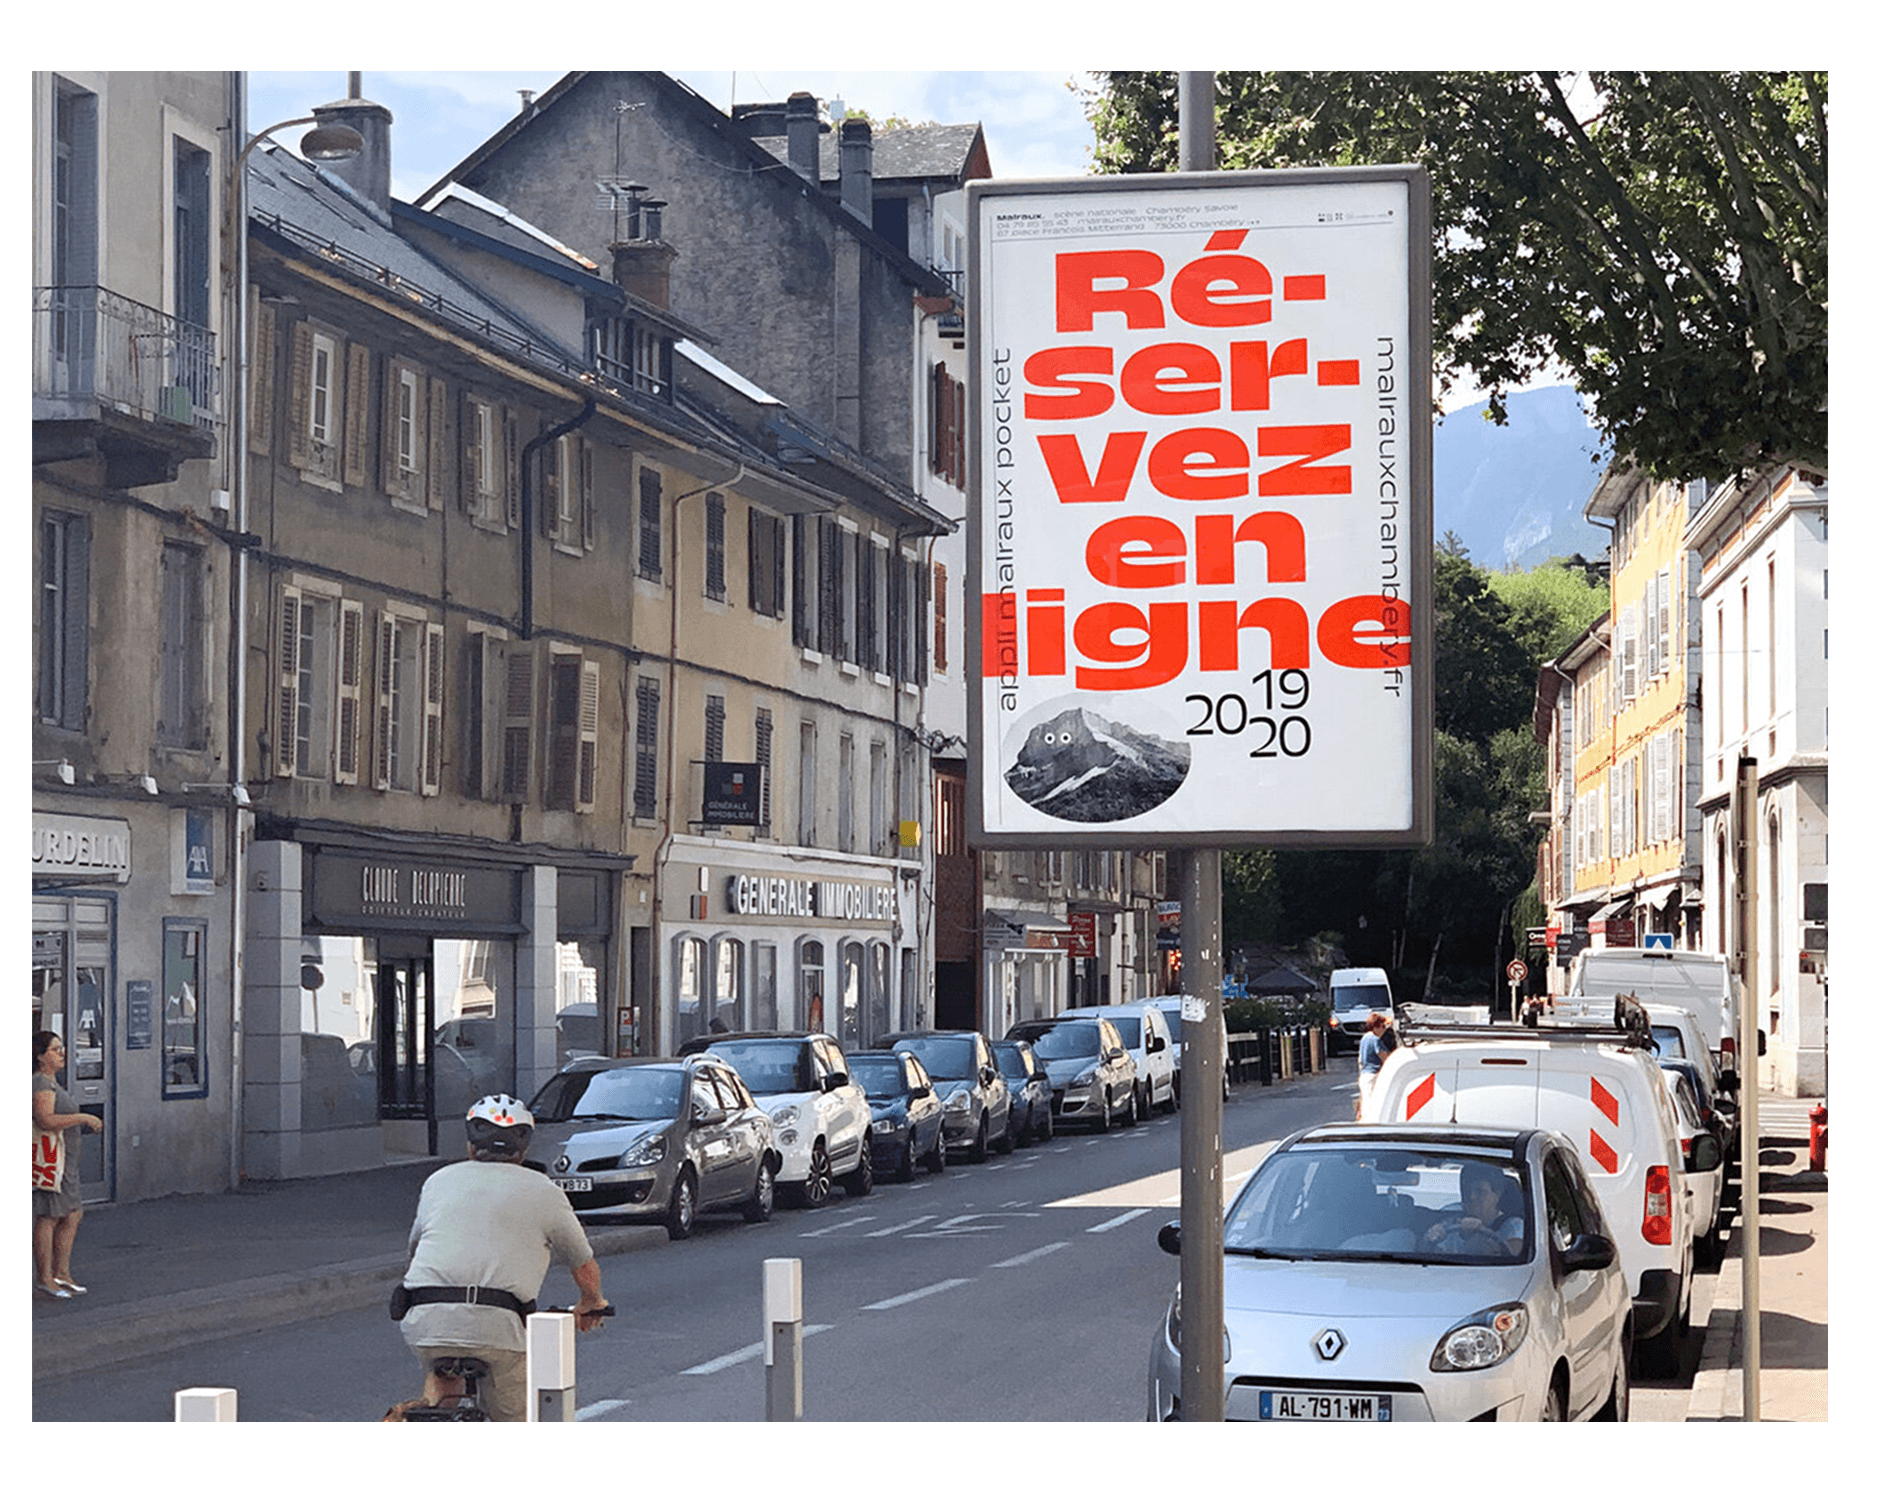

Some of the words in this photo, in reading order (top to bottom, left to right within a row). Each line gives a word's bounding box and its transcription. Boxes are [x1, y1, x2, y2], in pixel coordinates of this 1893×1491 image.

[1056, 230, 1326, 333] Ré-
[993, 348, 1015, 468] pocket
[1024, 338, 1360, 420] ser-
[1036, 424, 1352, 503] vez
[996, 479, 1015, 619] malraux
[1085, 511, 1306, 589] en
[1377, 337, 1403, 697] malrauxchambery.fr
[982, 589, 1412, 691] ligne
[998, 630, 1019, 711] appli
[1185, 693, 1248, 735] 20
[1252, 668, 1311, 710] 19
[1249, 715, 1312, 758] 20
[363, 866, 399, 903] CLAUDE
[738, 874, 814, 918] GENERALE
[822, 881, 898, 921] IMMOBILIERE
